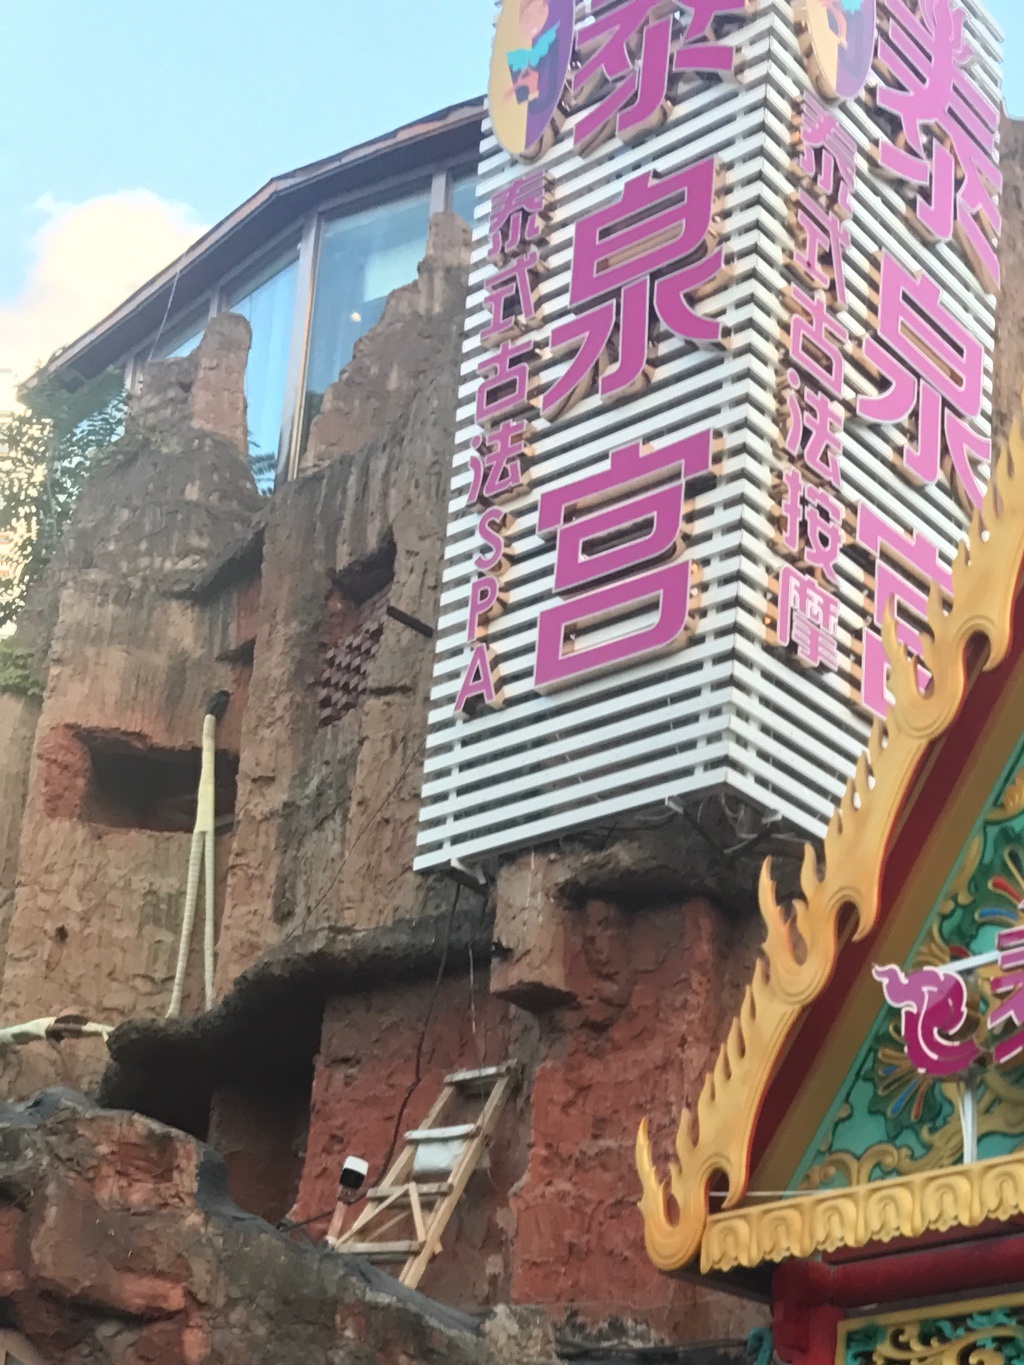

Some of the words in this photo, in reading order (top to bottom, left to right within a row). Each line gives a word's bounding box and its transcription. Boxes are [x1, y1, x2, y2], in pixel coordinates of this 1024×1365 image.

[454, 168, 546, 712] 泰式古法SPA
[778, 90, 857, 671] 泰式古法按摩
